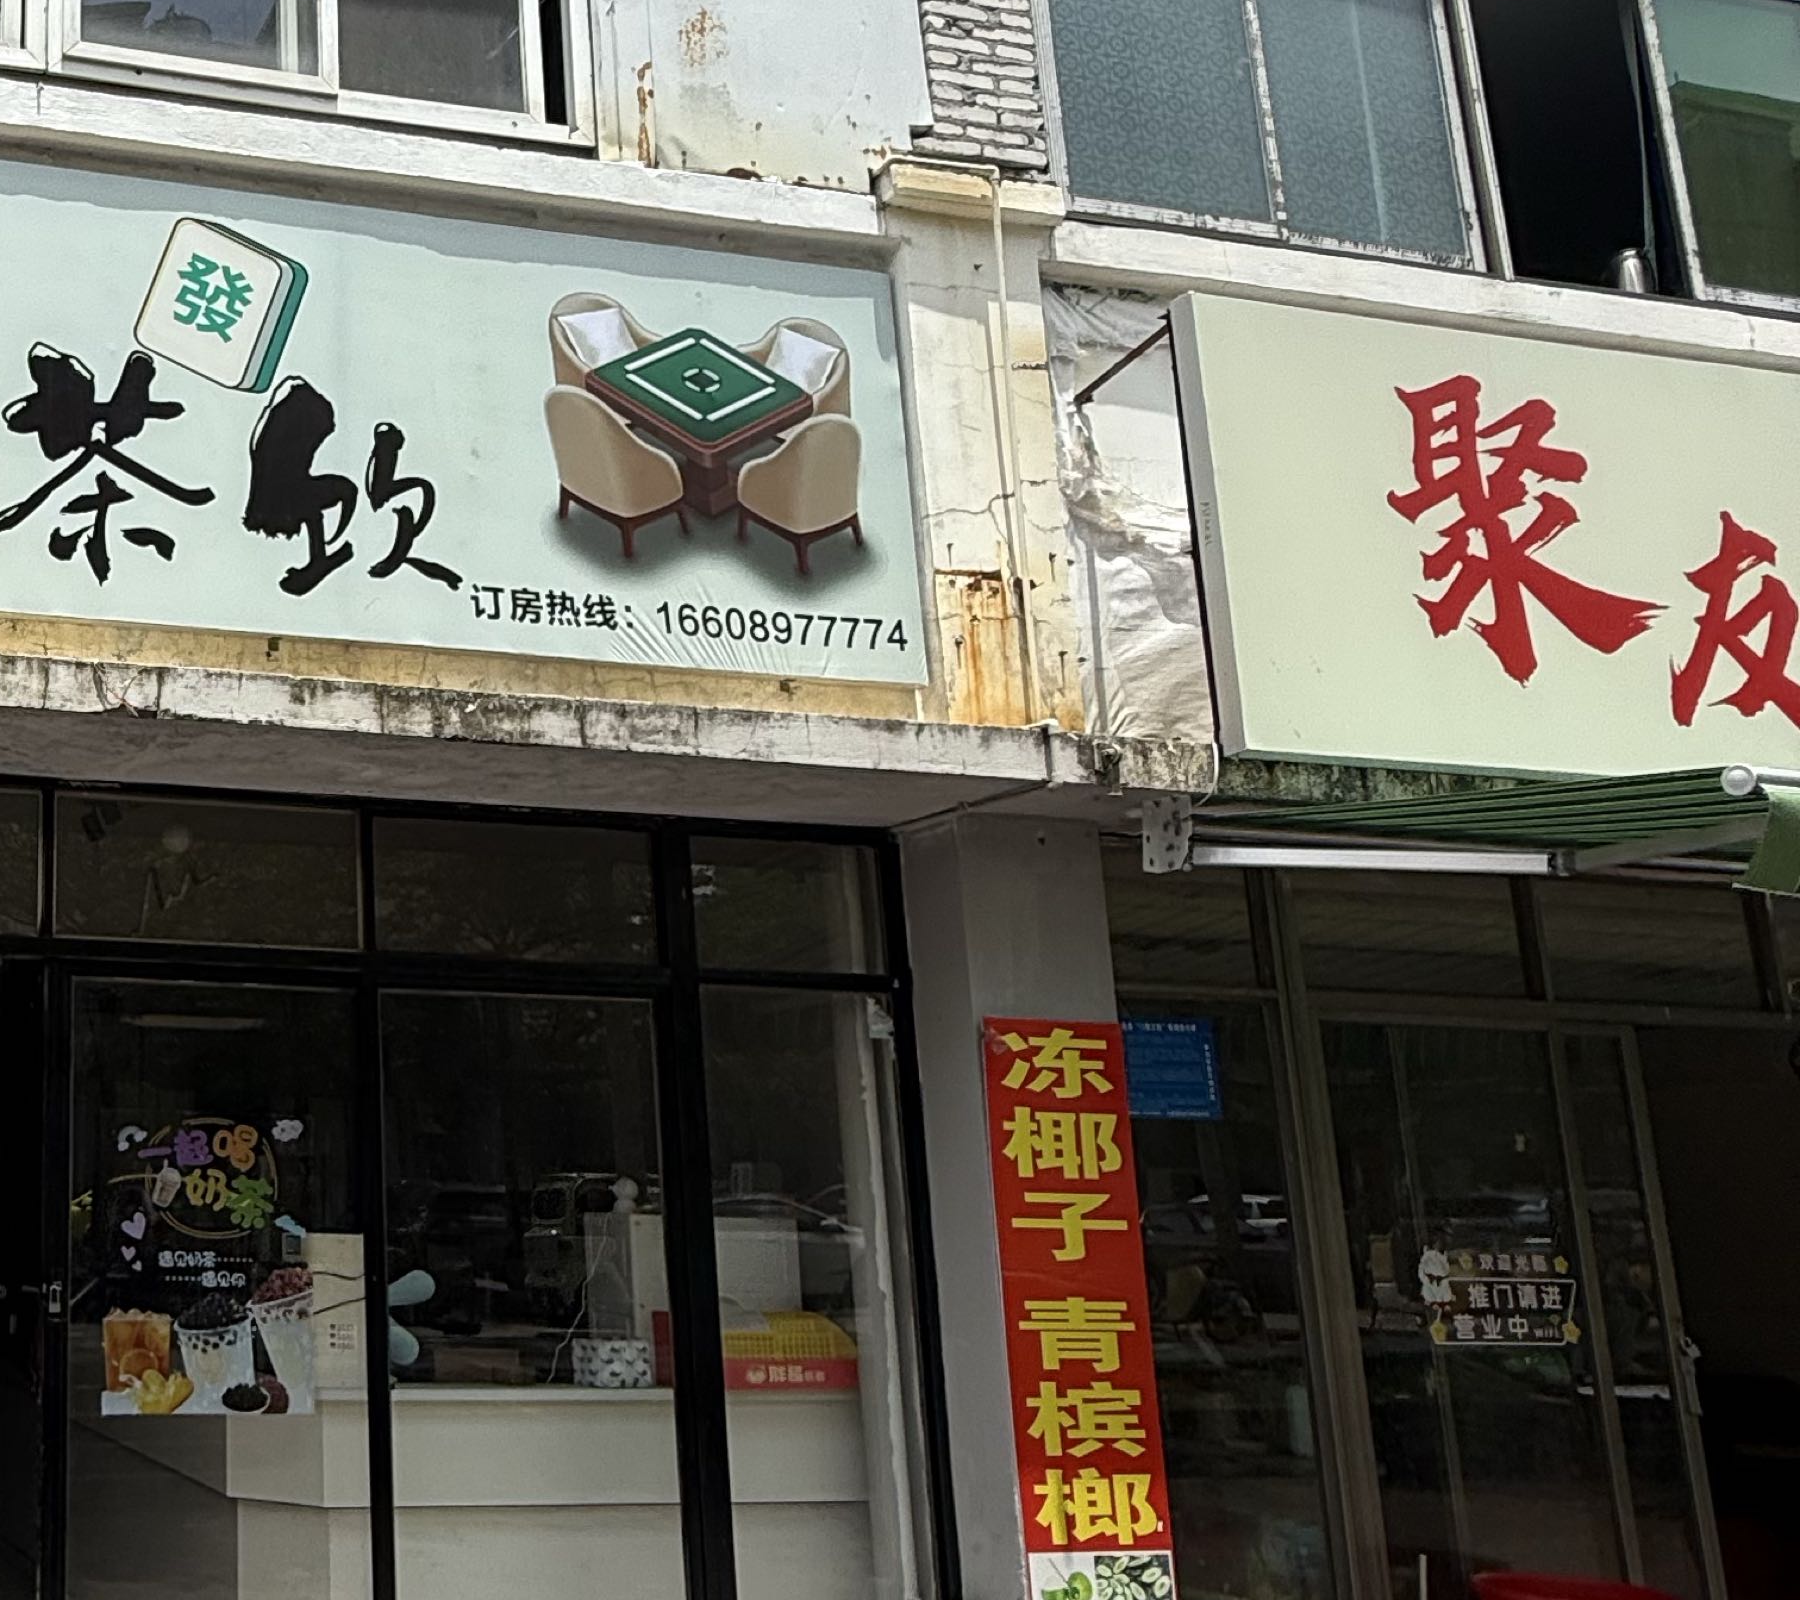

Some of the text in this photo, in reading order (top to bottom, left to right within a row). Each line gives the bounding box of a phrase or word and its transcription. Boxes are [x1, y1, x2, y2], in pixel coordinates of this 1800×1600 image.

[172, 251, 254, 344] 發
[1467, 1282, 1564, 1311] 推门请进
[1452, 1313, 1530, 1341] 营业中
